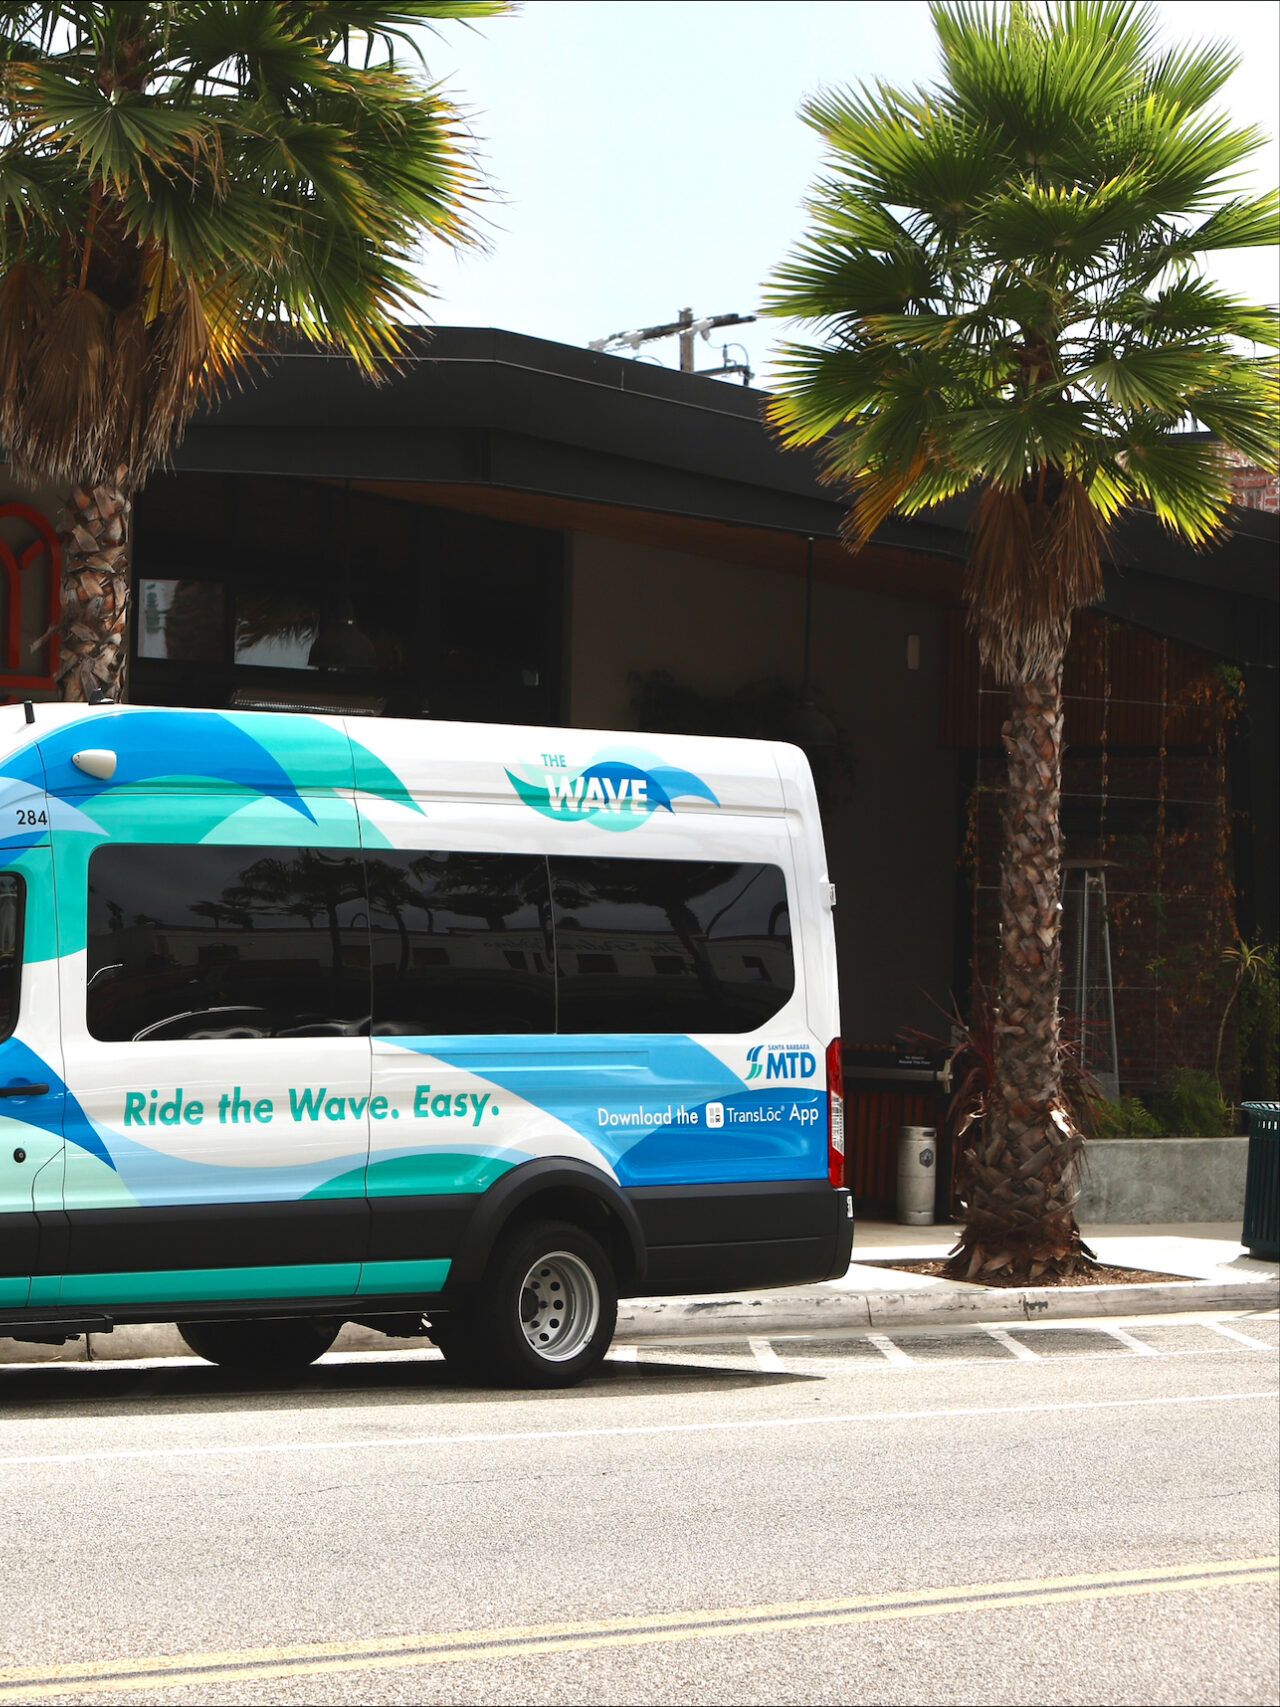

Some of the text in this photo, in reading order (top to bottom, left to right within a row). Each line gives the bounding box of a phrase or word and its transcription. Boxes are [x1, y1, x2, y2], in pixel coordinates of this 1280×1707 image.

[540, 753, 567, 768] THE
[544, 774, 648, 816] WAVE
[16, 809, 48, 826] 284
[768, 1043, 810, 1051] SANTA BARBARA
[766, 1051, 817, 1079] MTD
[123, 1084, 500, 1127] Ride the Wave. Easy.
[598, 1105, 672, 1127] Download
[676, 1104, 699, 1125] the
[789, 1103, 819, 1127] App
